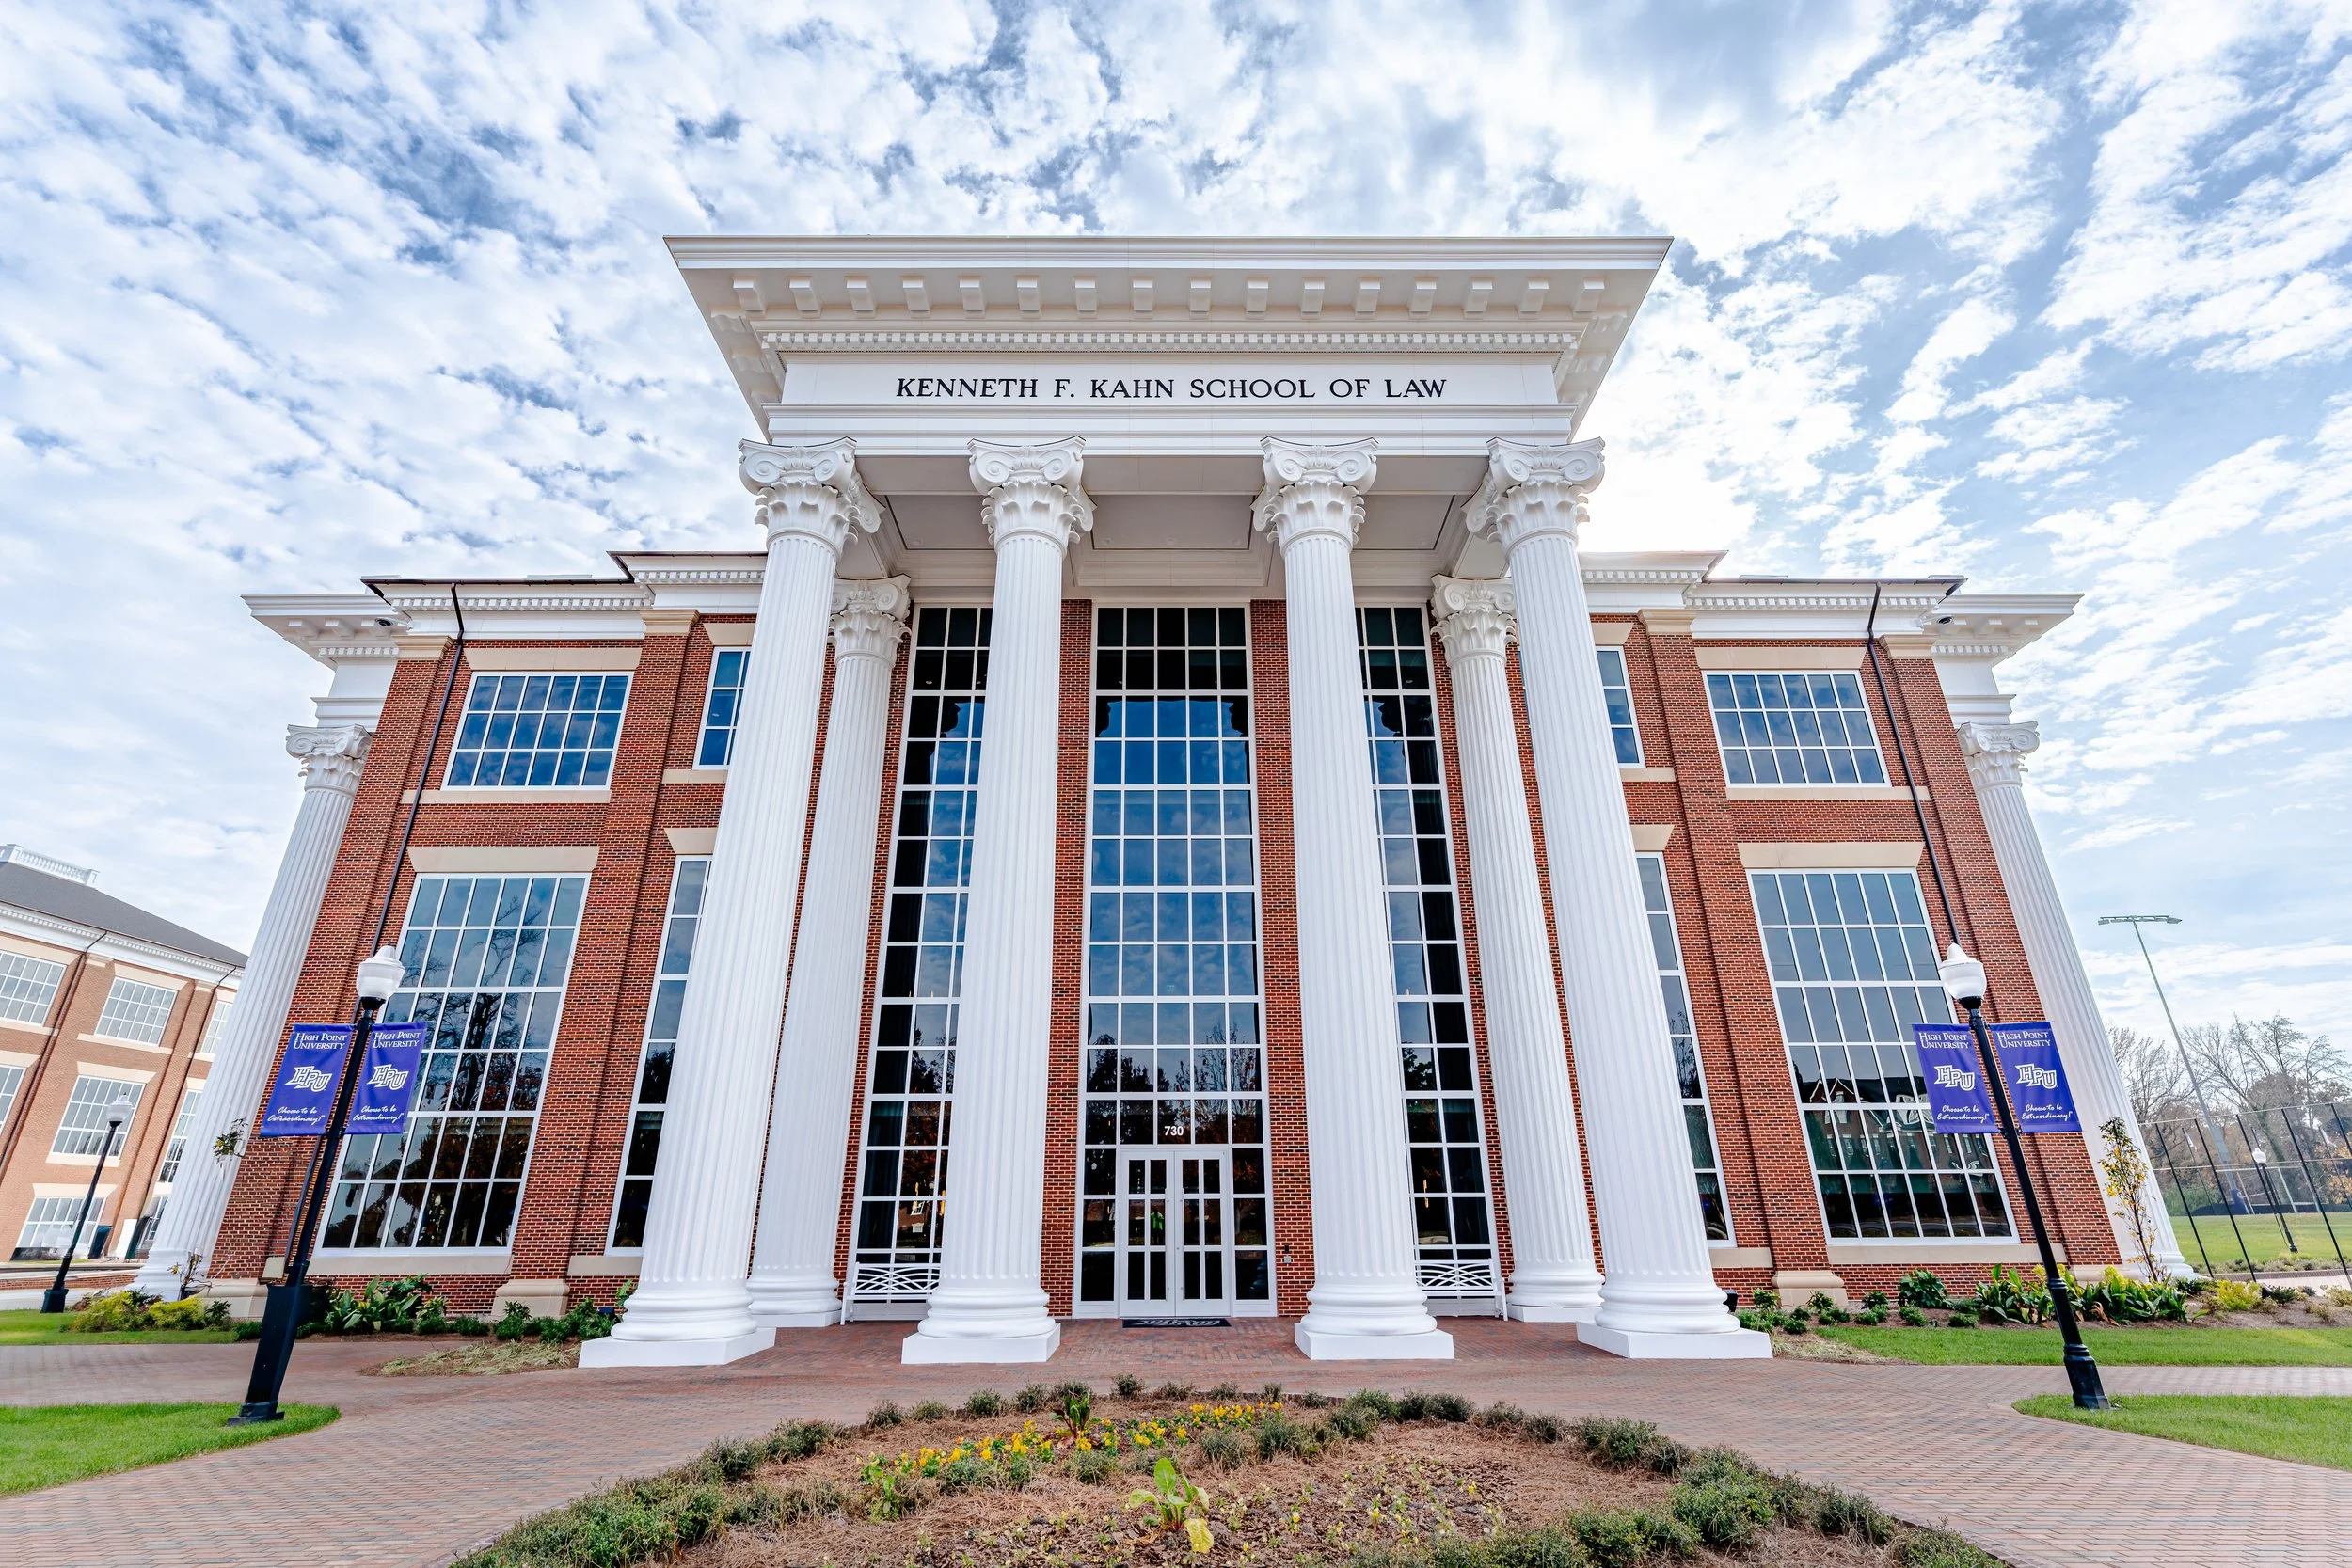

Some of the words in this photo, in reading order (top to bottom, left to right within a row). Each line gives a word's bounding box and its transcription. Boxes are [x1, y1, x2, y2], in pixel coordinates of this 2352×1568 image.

[896, 378, 1039, 398] KENNETH
[1053, 378, 1074, 398] F.
[1089, 378, 1175, 399] KAHN
[1190, 378, 1316, 399] SCHOOL
[1329, 378, 1371, 398] OF
[1384, 379, 1447, 398] LAW
[295, 1033, 318, 1041] HIGH
[321, 1033, 347, 1041] POINT
[374, 1032, 395, 1040] HIGH
[396, 1031, 421, 1039] POINT
[1919, 1033, 1942, 1041] HIGH
[1944, 1033, 1967, 1041] POINT
[1997, 1032, 2021, 1040] HIGH
[2023, 1031, 2048, 1039] POINT
[373, 1040, 420, 1049] UNIVERSITY
[1921, 1040, 1969, 1049] UNIVERSITY
[1999, 1039, 2051, 1049] UNIVERSITY
[285, 1066, 332, 1092] HPU
[367, 1064, 408, 1091] HPU
[1934, 1065, 1975, 1091] HPU
[2015, 1063, 2058, 1089] HPU
[1973, 1104, 1979, 1113] be
[1164, 1125, 1184, 1136] 730
